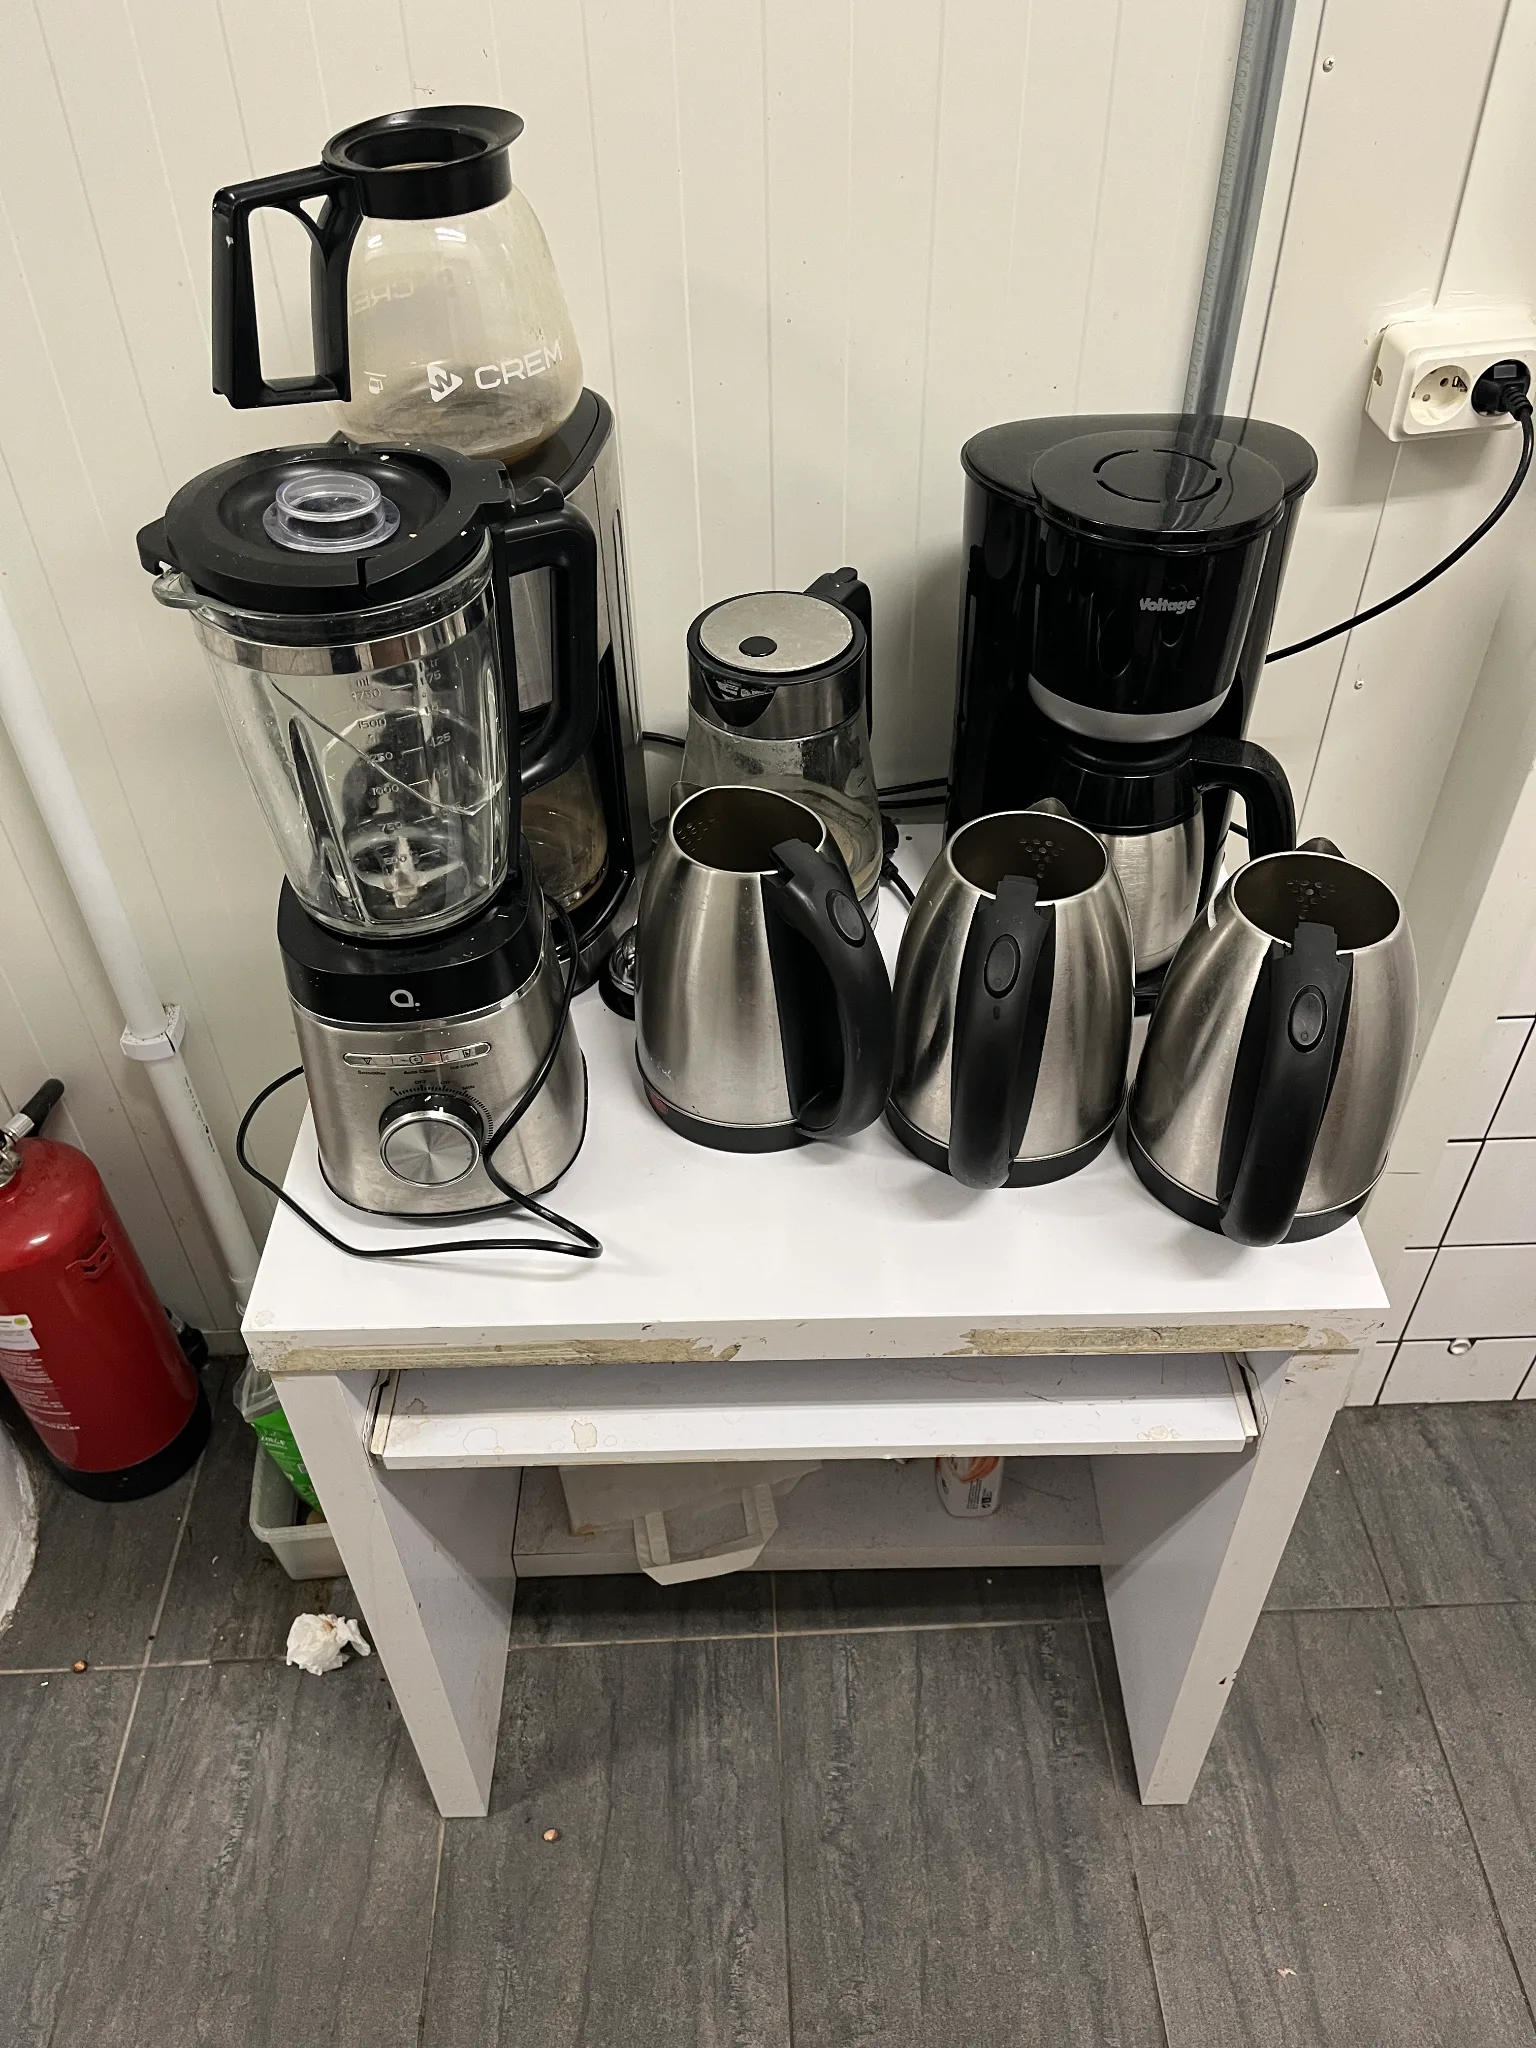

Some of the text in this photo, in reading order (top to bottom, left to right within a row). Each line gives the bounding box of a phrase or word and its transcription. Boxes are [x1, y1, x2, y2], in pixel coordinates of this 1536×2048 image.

[474, 338, 563, 390] CREM
[1139, 597, 1197, 615] Voltage
[357, 718, 387, 730] 1500
[371, 784, 400, 797] 1000
